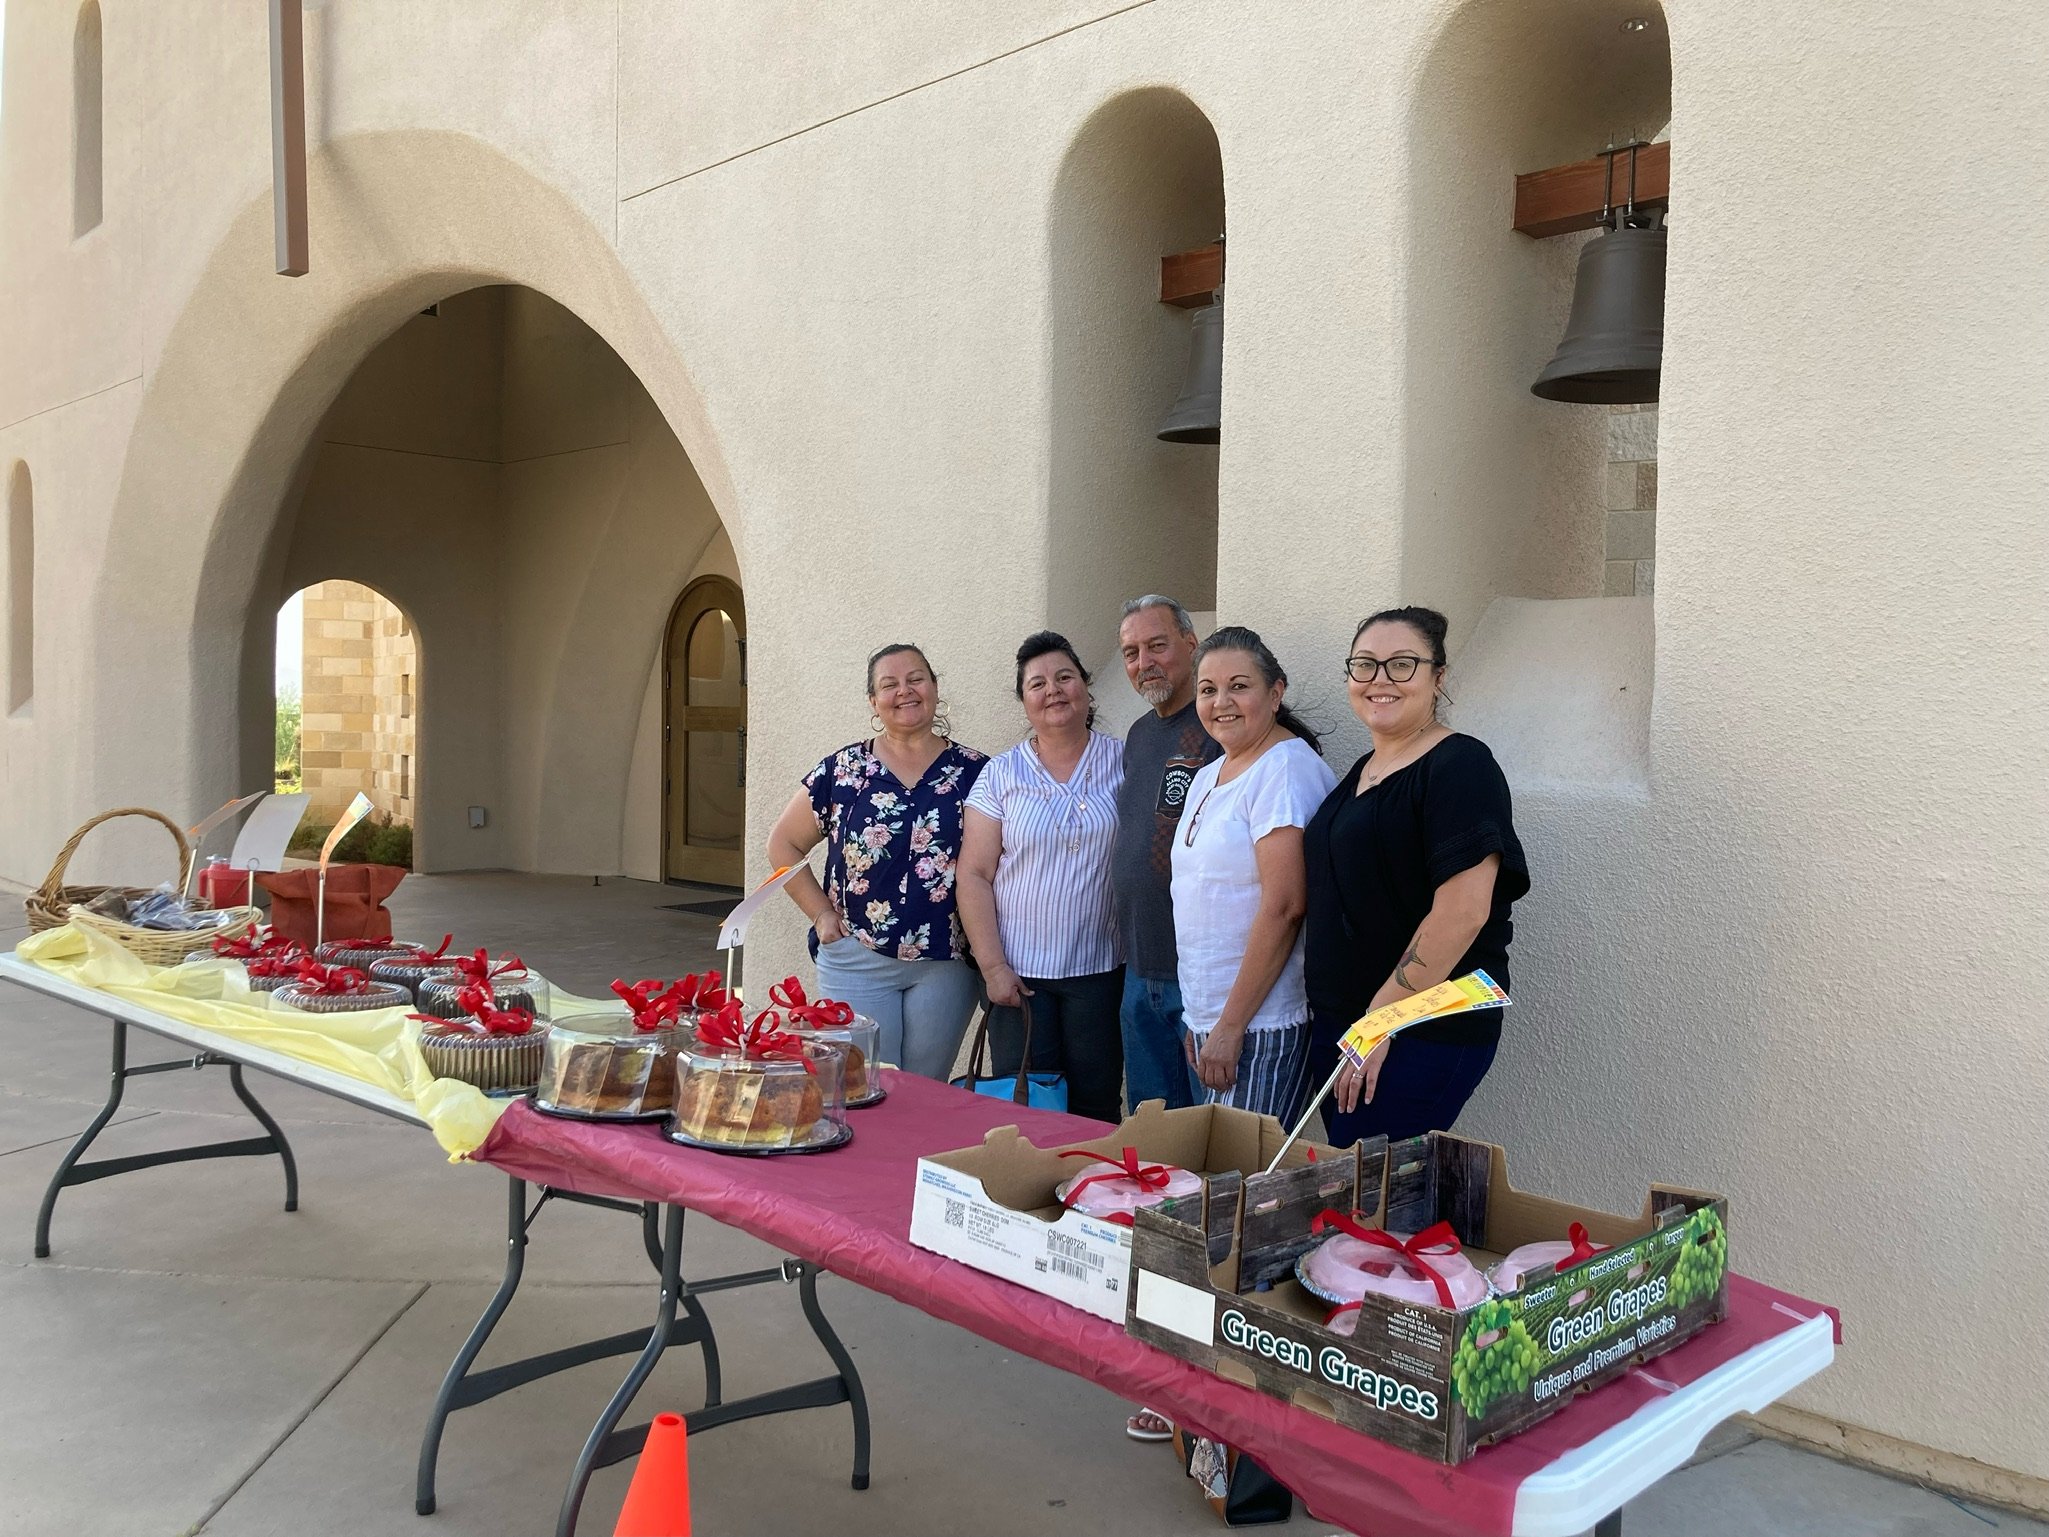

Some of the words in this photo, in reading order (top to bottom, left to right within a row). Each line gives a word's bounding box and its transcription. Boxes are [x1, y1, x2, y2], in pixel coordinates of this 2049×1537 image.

[1166, 770, 1192, 783] COWBOY'S
[1181, 780, 1189, 788] CITY
[1047, 1229, 1087, 1250] CSWC007221
[1589, 1260, 1607, 1281] Hand
[1608, 1248, 1635, 1271] Selected
[1387, 1316, 1407, 1326] PRODUIT
[1393, 1312, 1415, 1324] PRODUCE
[1404, 1308, 1421, 1319] CAT.
[1548, 1306, 1604, 1354] Green
[1607, 1275, 1666, 1324] Grapes
[1388, 1330, 1407, 1340] PRODUIT
[1388, 1324, 1408, 1335] PRODUCT
[1415, 1334, 1441, 1347] CALIFORNIA
[1221, 1309, 1312, 1374] Green
[1319, 1346, 1439, 1420] Grapes
[1534, 1370, 1572, 1402] Unique
[1573, 1353, 1592, 1381] and
[1593, 1336, 1636, 1371] Premium
[1637, 1315, 1677, 1347] Varieties
